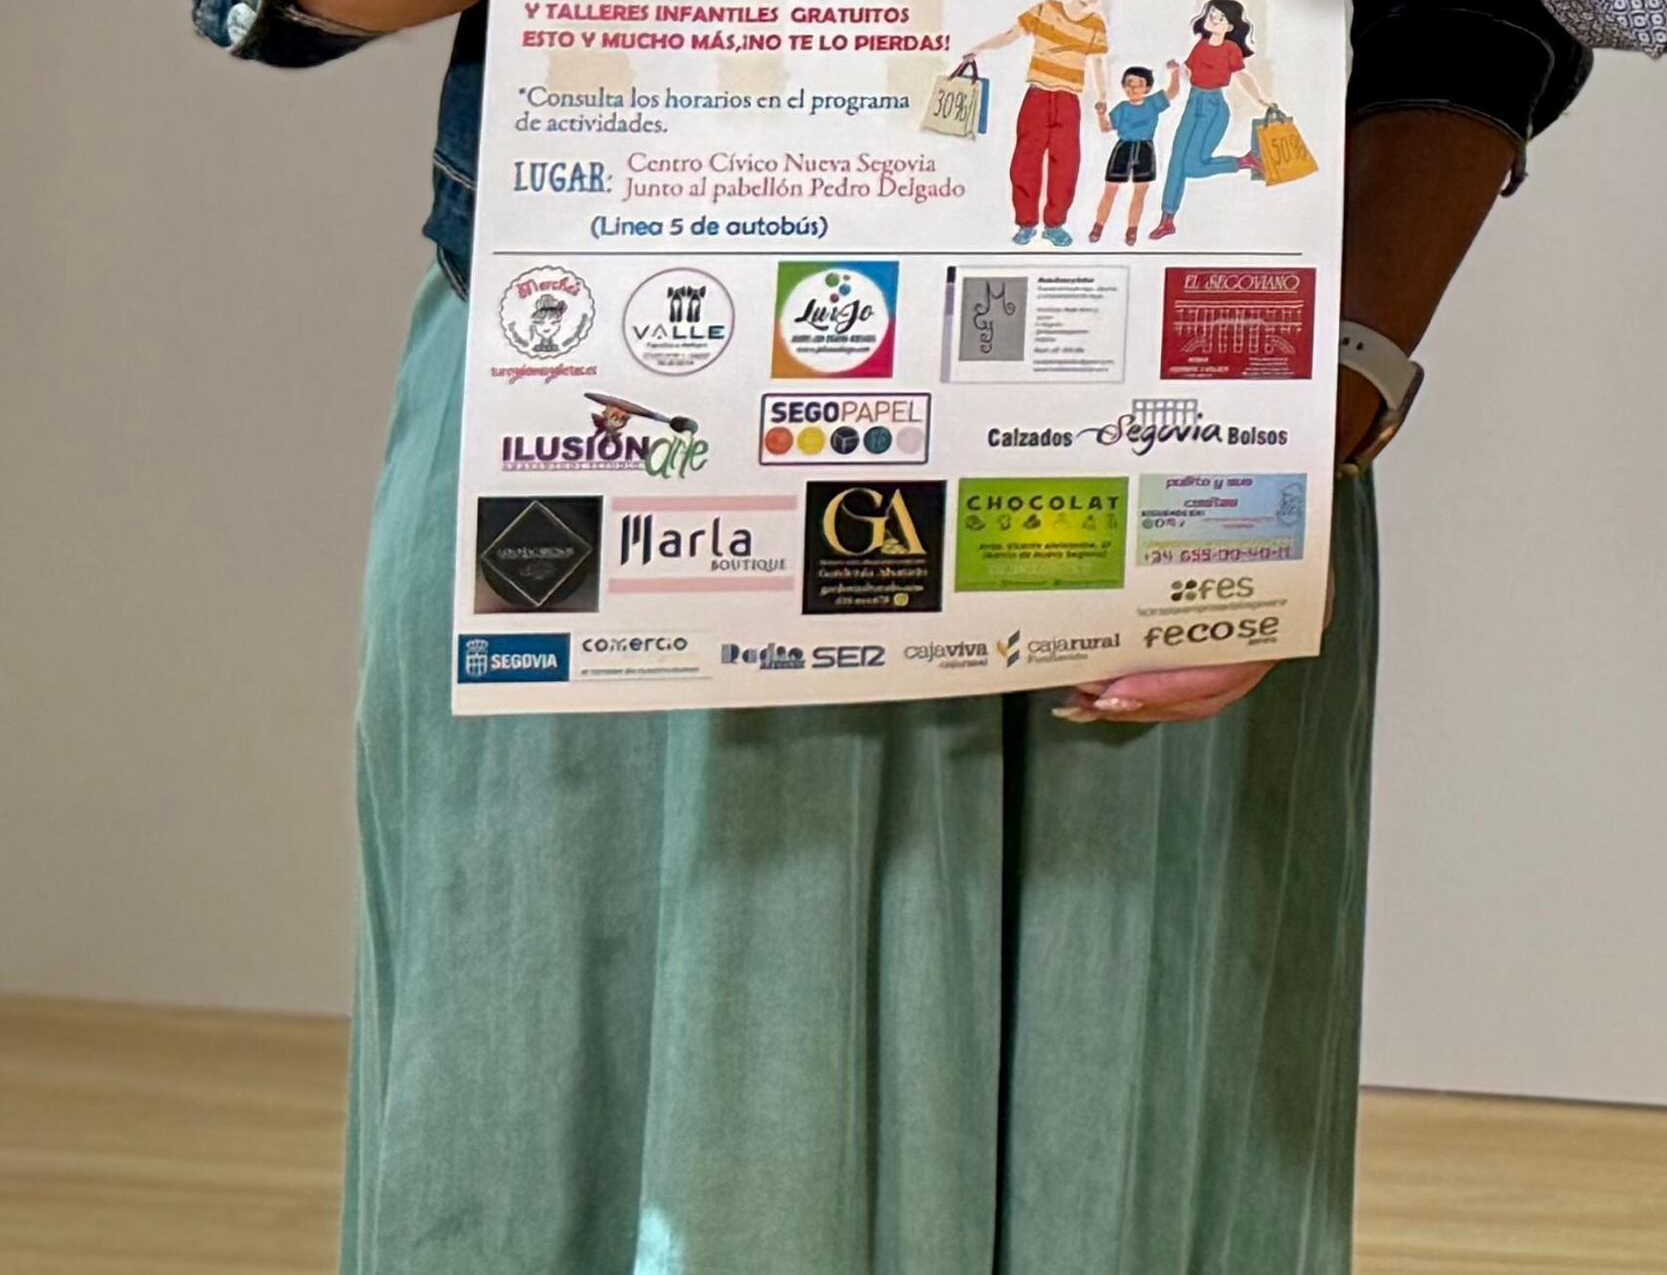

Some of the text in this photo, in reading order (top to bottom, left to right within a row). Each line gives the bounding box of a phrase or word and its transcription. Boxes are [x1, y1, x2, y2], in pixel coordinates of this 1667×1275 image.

[628, 85, 659, 108] los
[664, 86, 752, 109] horarios
[756, 95, 781, 109] en
[786, 87, 805, 109] el
[809, 95, 910, 116] programa
[513, 109, 668, 134] de actividades.
[513, 160, 613, 193] LUGAR:
[626, 151, 936, 177] Centro Cívico Nueva Segovia
[770, 400, 922, 424] SEGOPAPEL
[987, 410, 1288, 457] Calzados Segovia Bolsos
[620, 513, 752, 566] Marla
[709, 557, 786, 573] BOUTIQUE
